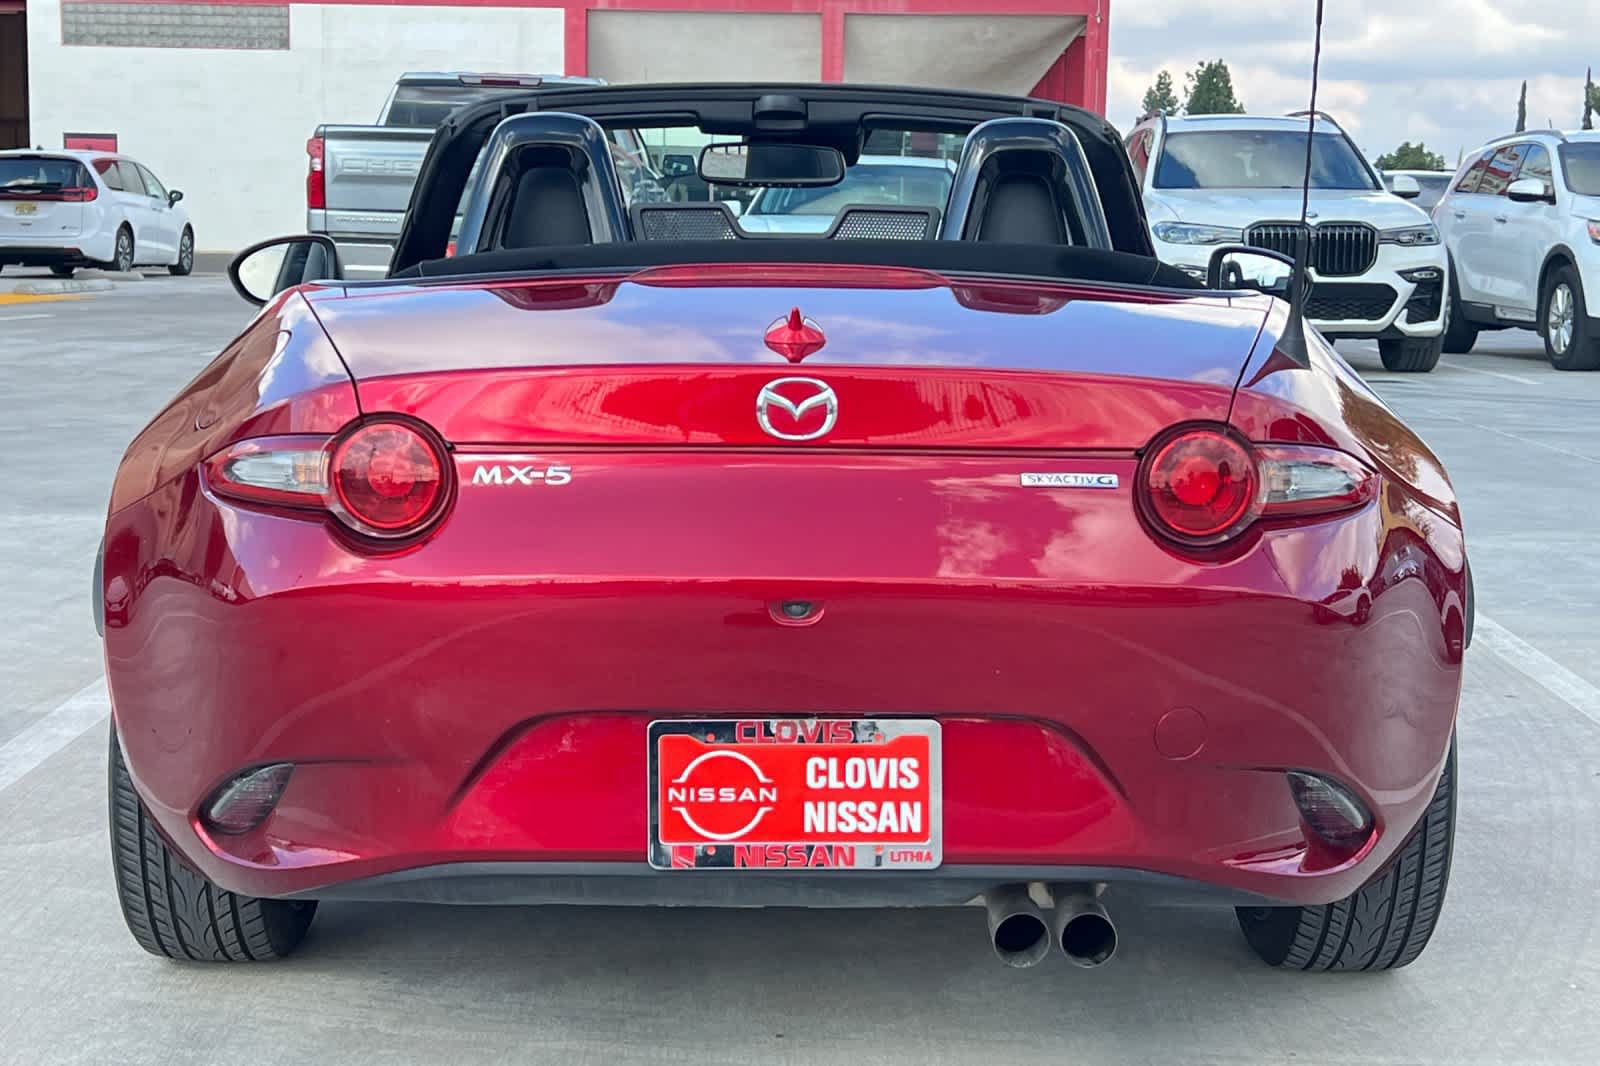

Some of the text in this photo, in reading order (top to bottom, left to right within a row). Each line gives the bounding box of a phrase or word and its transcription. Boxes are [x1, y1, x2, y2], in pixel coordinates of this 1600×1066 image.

[472, 465, 572, 485] MX-5
[735, 720, 855, 743] CLOVIS
[806, 757, 920, 789] CLOVIS
[668, 788, 777, 803] NISSAN
[804, 801, 921, 833] NISSAN
[734, 845, 854, 867] NISSAN
[890, 849, 933, 863] LITHIA
